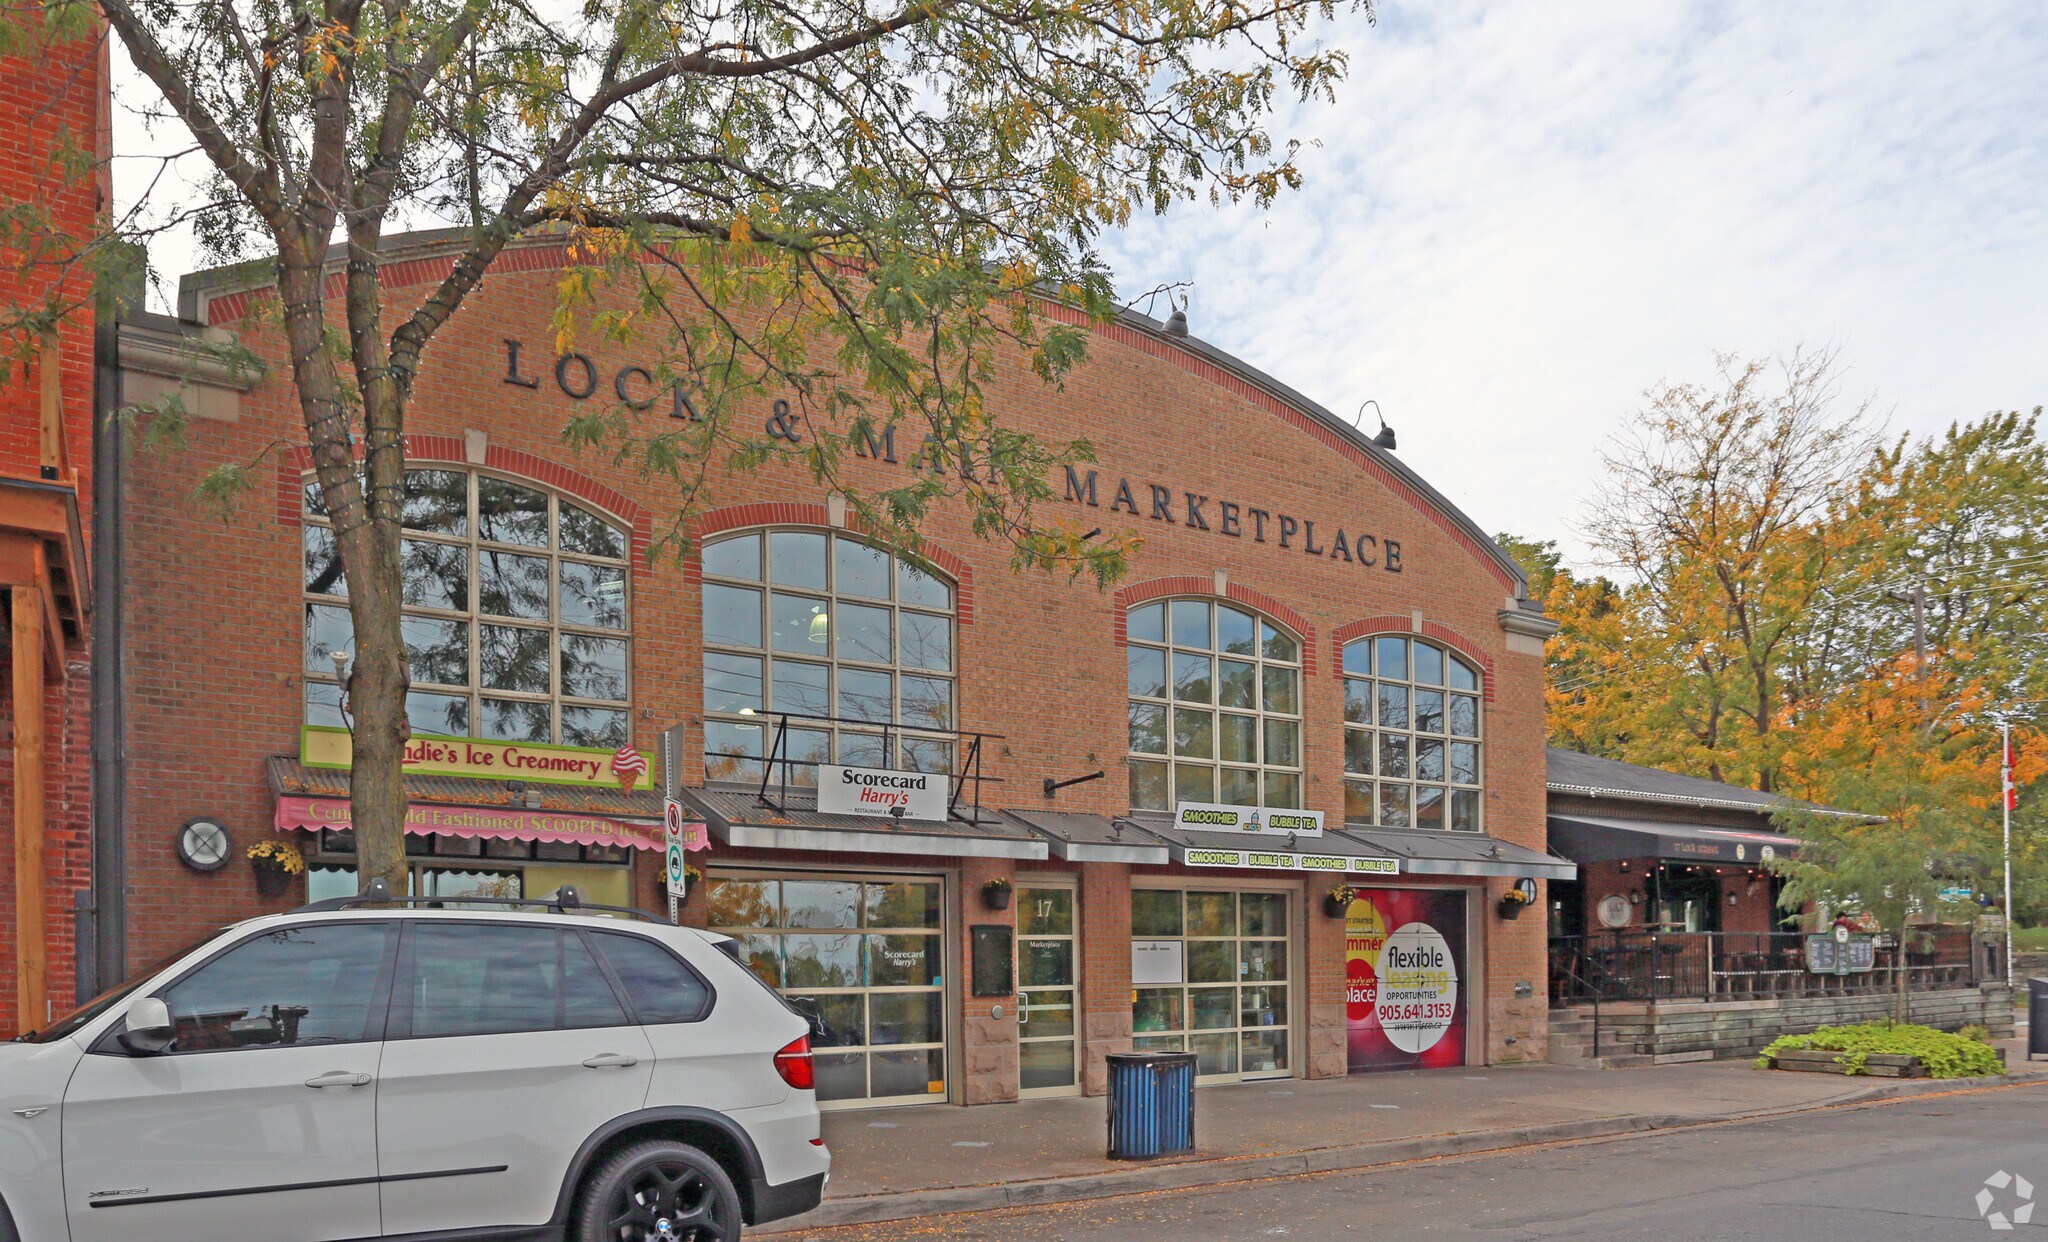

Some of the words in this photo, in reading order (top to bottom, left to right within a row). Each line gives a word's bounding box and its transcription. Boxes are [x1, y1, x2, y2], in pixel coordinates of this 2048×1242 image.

[503, 338, 706, 423] LOCK
[765, 399, 802, 442] &
[1063, 464, 1404, 573] MARKETPLACE
[402, 740, 458, 765] ndie's
[466, 744, 494, 766] Ice
[502, 747, 602, 780] Creamery
[842, 769, 926, 790] Scorecard
[860, 787, 909, 807] Harry's
[854, 807, 882, 815] RESTAURANT
[1182, 810, 1239, 825] SMOOTHIES
[1269, 815, 1301, 829] BUBBLE
[1302, 817, 1318, 830] TEA
[404, 808, 427, 825] ld
[432, 810, 525, 830] Fashioned
[530, 816, 614, 835] SCOOPED
[1189, 852, 1240, 865] SMOOTHIES
[1249, 853, 1278, 866] BUBBLE
[1279, 855, 1294, 867] TEA
[1301, 856, 1347, 870] SMOOTHIES
[1355, 858, 1381, 871] BUBBLE
[1382, 860, 1396, 872] TEA
[1036, 899, 1053, 917] 17
[1030, 941, 1061, 949] Marketplace
[1347, 937, 1384, 951] mmer
[884, 951, 925, 959] Scorecard
[893, 958, 917, 968] Harry's
[1388, 946, 1444, 968] flexible
[1385, 964, 1449, 994] leasing
[1379, 1003, 1452, 1020] 905.641.3153
